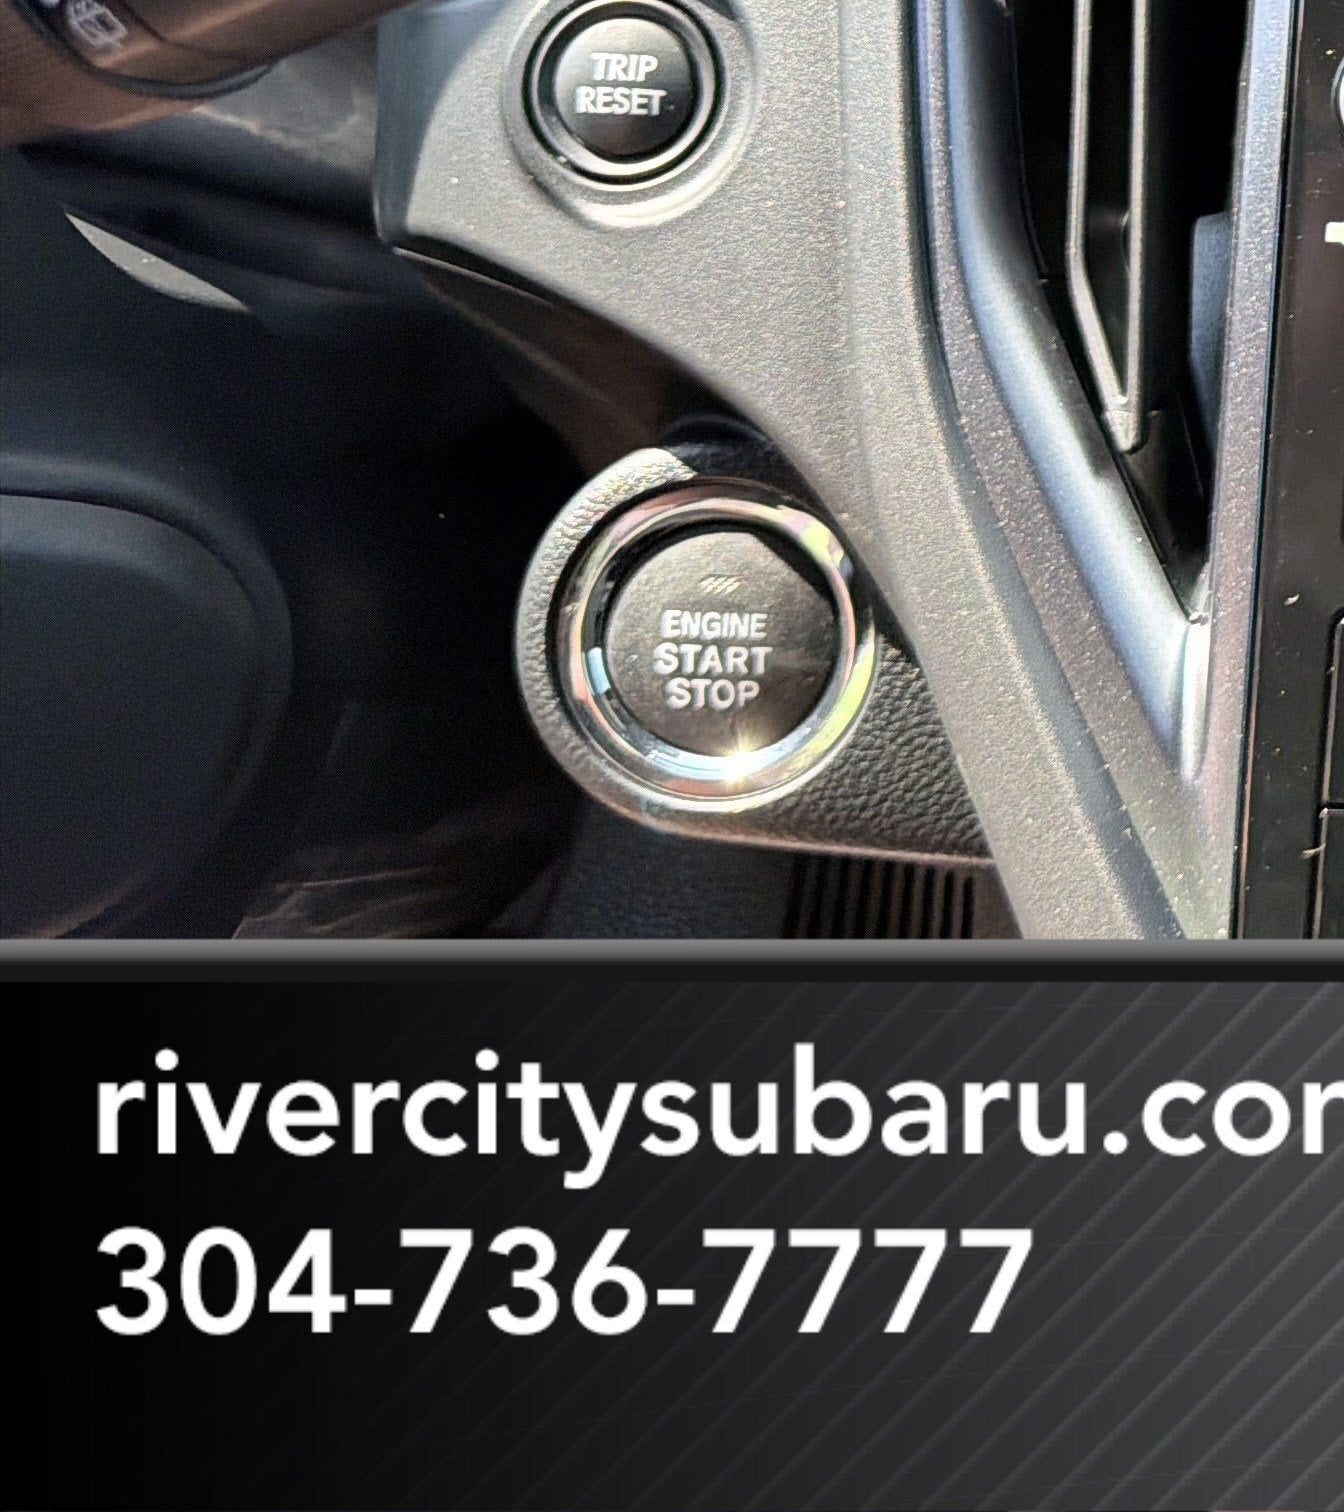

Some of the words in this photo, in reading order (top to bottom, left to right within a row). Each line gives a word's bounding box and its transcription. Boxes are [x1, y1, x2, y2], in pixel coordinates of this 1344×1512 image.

[588, 49, 658, 82] TRIP
[573, 83, 666, 115] RESET
[659, 608, 767, 640] ENGINE
[651, 641, 772, 675] START
[665, 675, 759, 710] STOP
